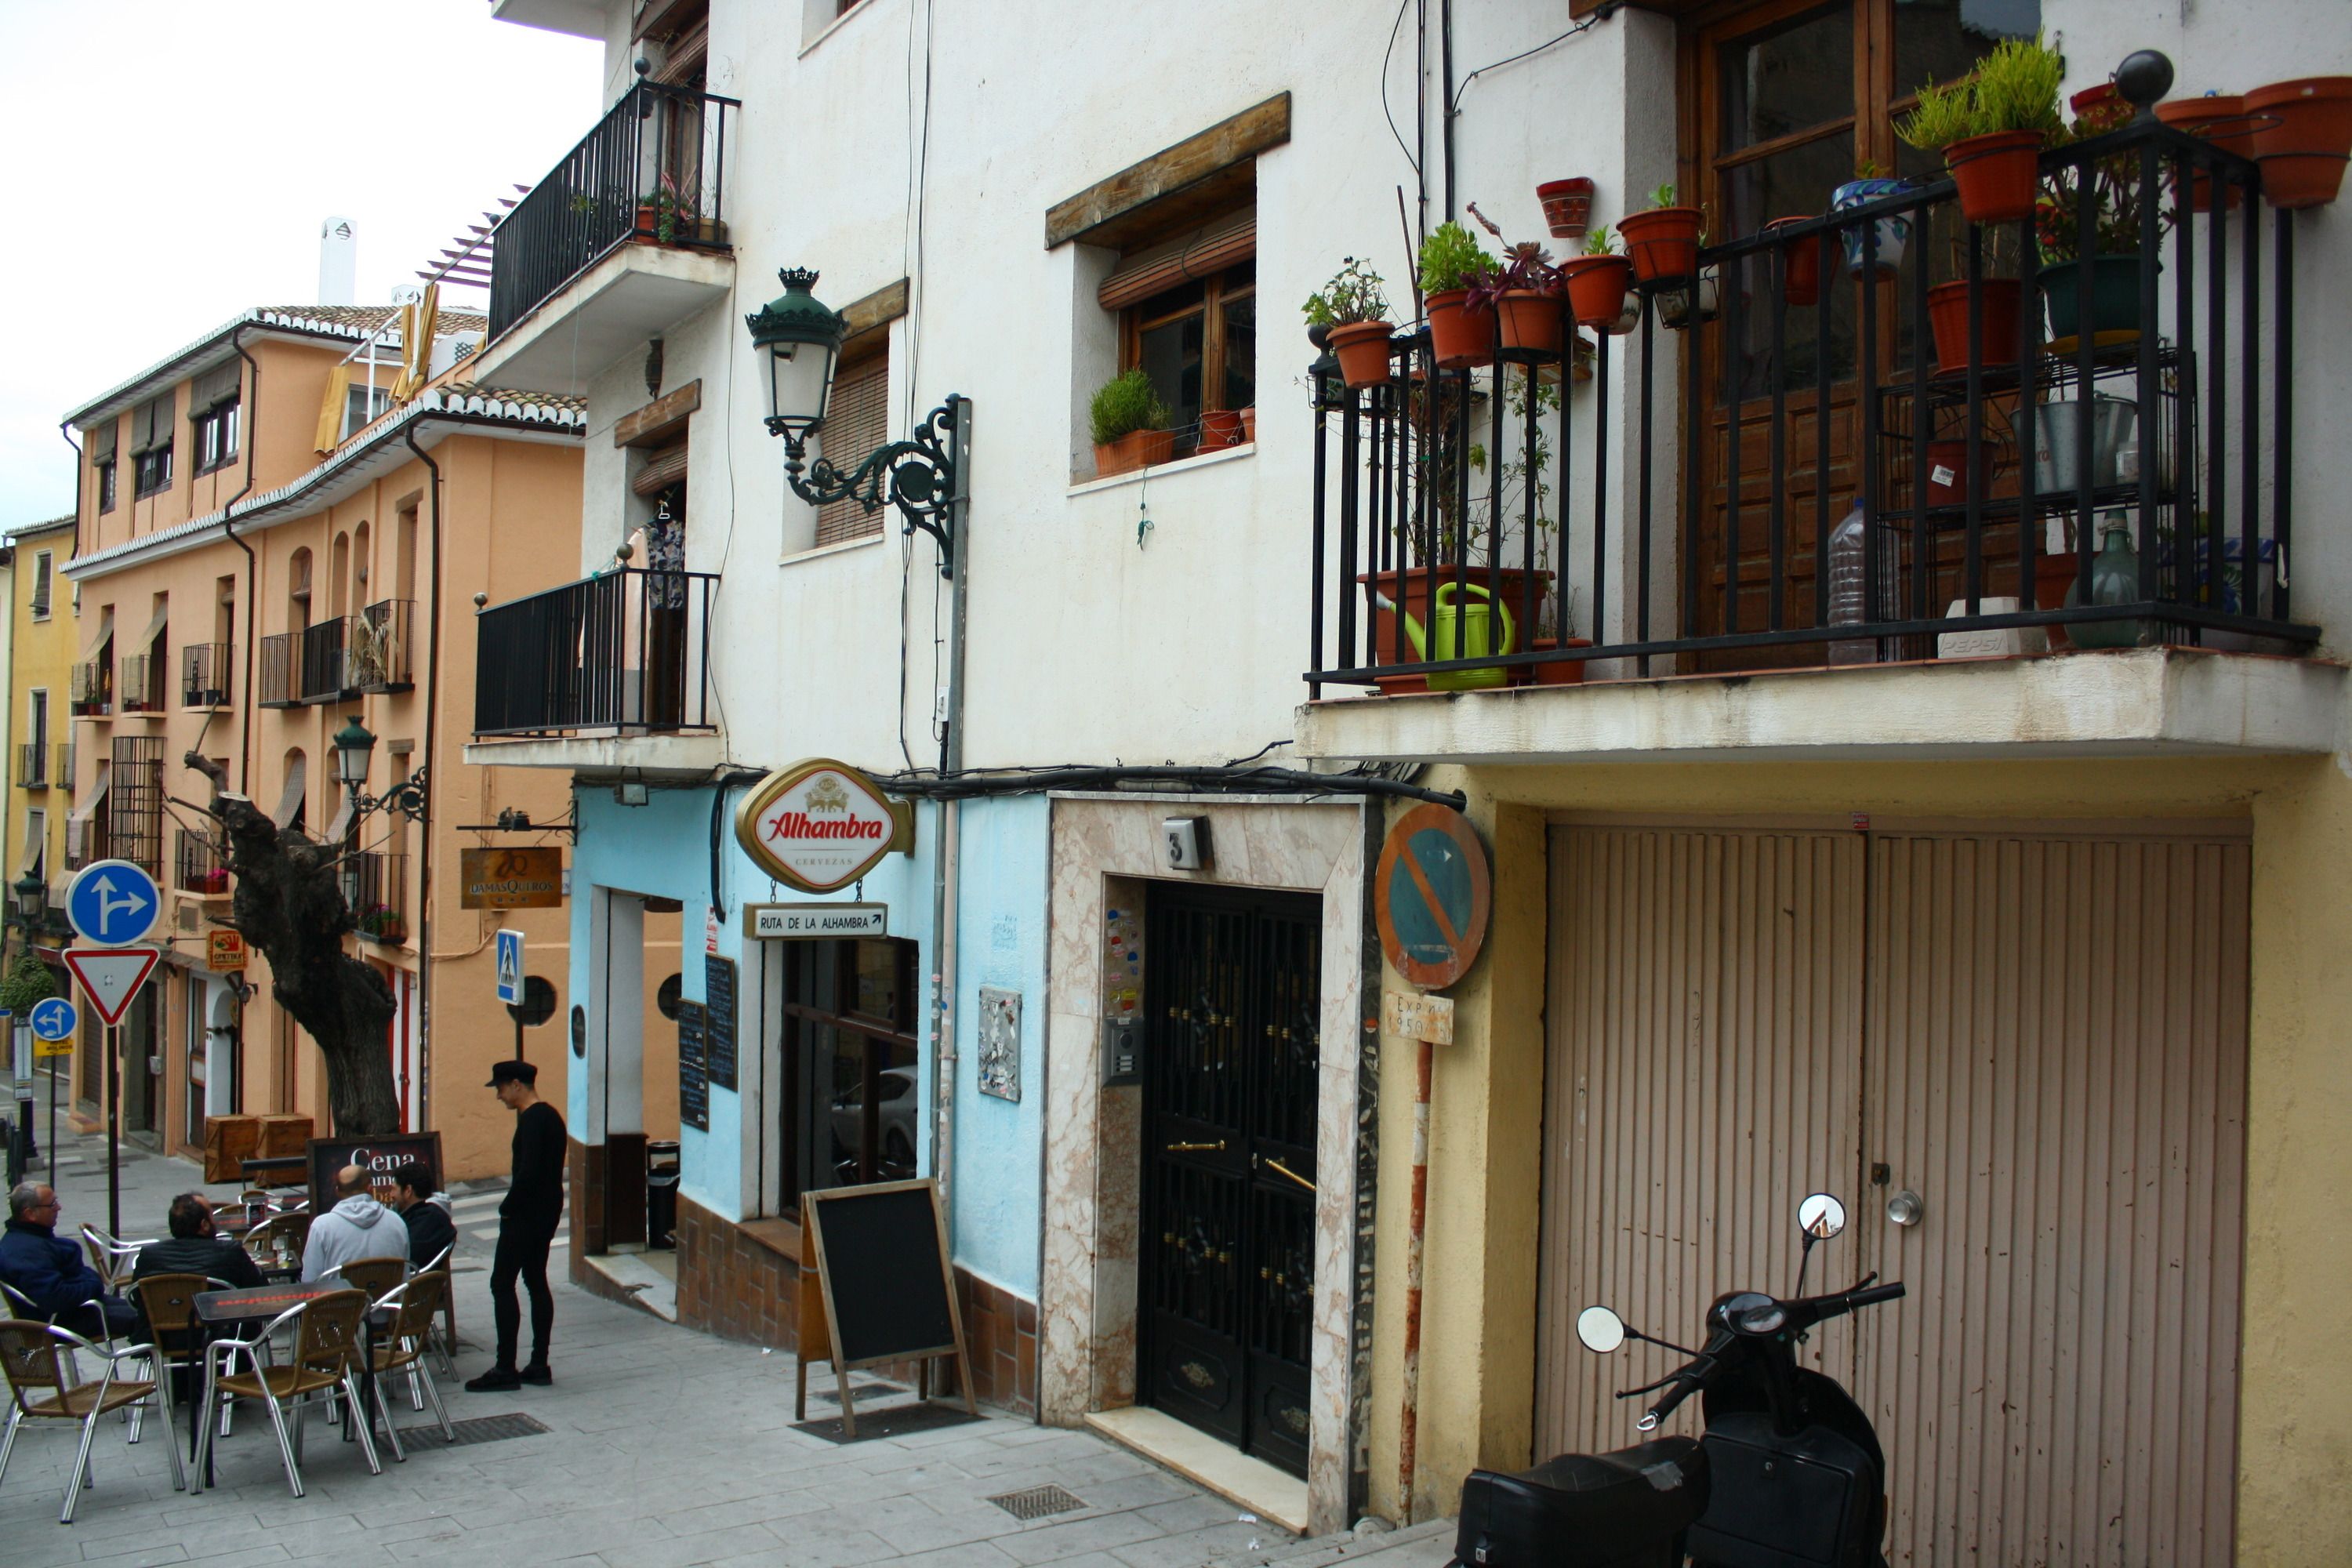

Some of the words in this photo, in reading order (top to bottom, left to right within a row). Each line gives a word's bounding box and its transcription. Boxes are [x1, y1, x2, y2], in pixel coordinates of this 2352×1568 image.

[1940, 637, 2003, 654] PEPSI
[767, 811, 883, 842] Alhambra
[1169, 833, 1182, 862] 3
[795, 858, 854, 866] CERVEZAS
[760, 917, 782, 929] RUTA
[788, 917, 800, 929] DE
[805, 917, 816, 928] LA
[822, 917, 869, 928] ALHAMBRA
[350, 1148, 415, 1171] Cena
